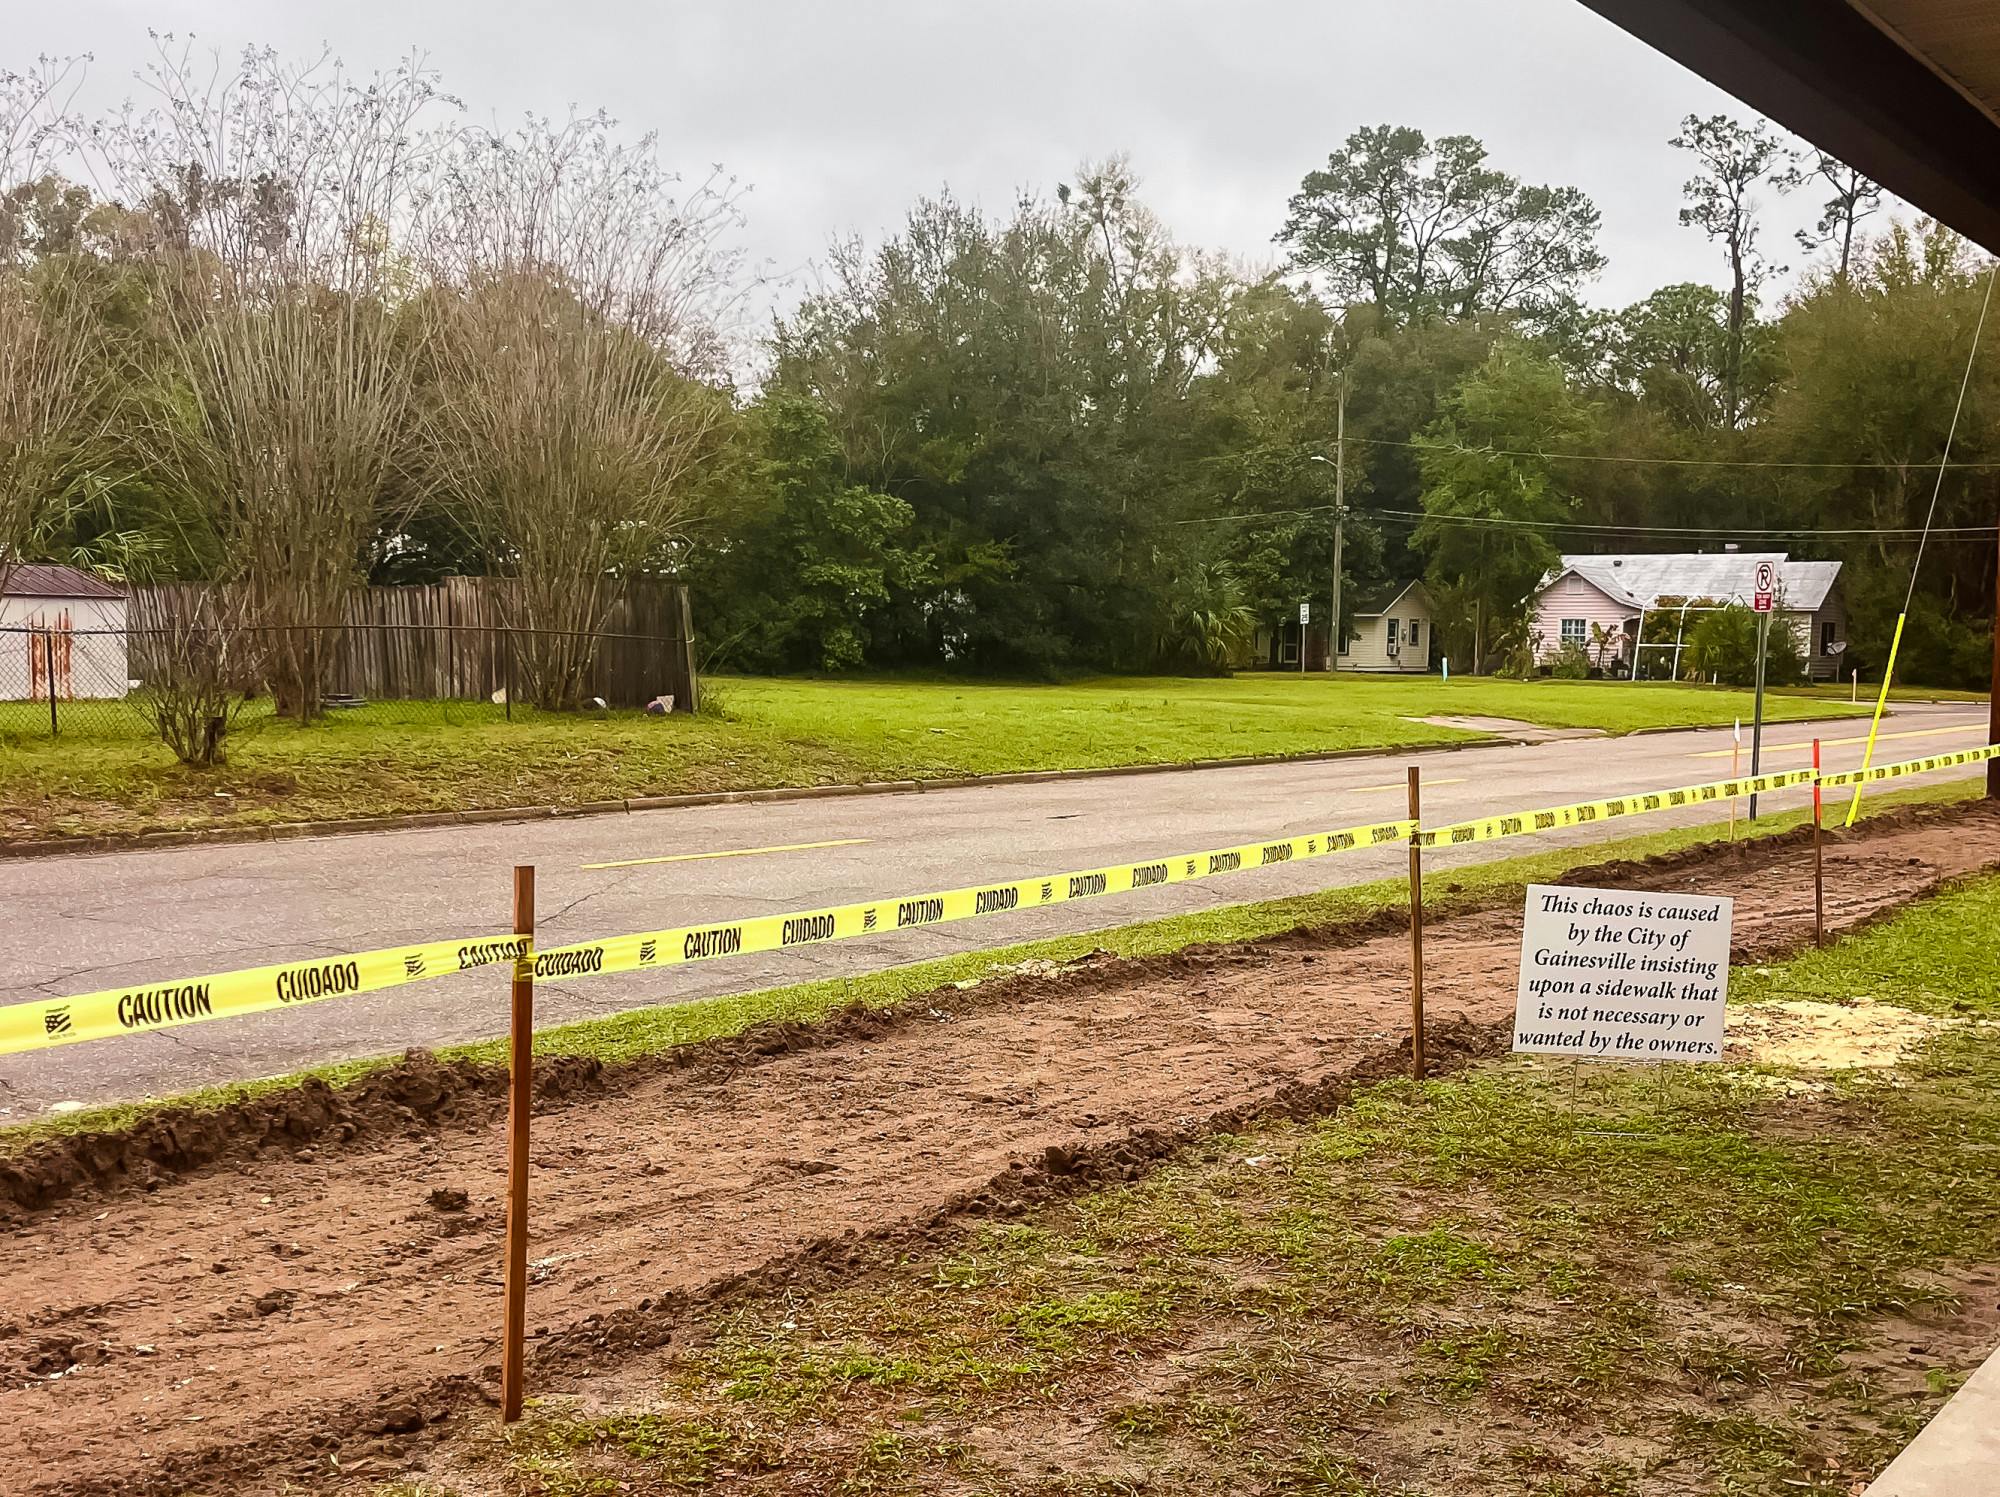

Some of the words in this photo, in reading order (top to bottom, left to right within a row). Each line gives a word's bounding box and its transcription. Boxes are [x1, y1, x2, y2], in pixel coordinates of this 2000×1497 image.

[535, 946, 604, 977] CUIDADO
[684, 928, 741, 958] CAUTION
[783, 914, 834, 944] CUIDADO
[898, 898, 943, 927] CAUTION
[975, 887, 1018, 914] CUIDADO
[1069, 874, 1106, 898] CAUTION
[1132, 864, 1168, 888] CUIDADO
[1209, 852, 1240, 874] CAUTION
[1541, 894, 1579, 914] This
[1582, 897, 1634, 917] chaos
[1638, 901, 1654, 919] is
[1657, 904, 1721, 922] caused
[1568, 923, 1590, 947] by
[1594, 924, 1623, 943] the
[1627, 927, 1666, 951] City
[1669, 929, 1692, 952] of
[1534, 948, 1636, 971] Gainesville
[1640, 954, 1719, 981] insisting
[118, 984, 213, 1028] CAUTION
[277, 961, 359, 1002] CUIDADO
[1529, 978, 1575, 998] upon
[1579, 982, 1592, 995] a
[1595, 979, 1677, 999] sidewalk
[1680, 982, 1720, 1002] that
[1538, 1002, 1553, 1019] is
[1557, 1005, 1589, 1021] not
[1592, 1009, 1680, 1031] necessary
[1684, 1014, 1705, 1027] or
[1518, 1030, 1586, 1047] wanted
[1588, 1030, 1612, 1054] by
[1615, 1031, 1645, 1050] the
[1648, 1038, 1718, 1055] owners.
